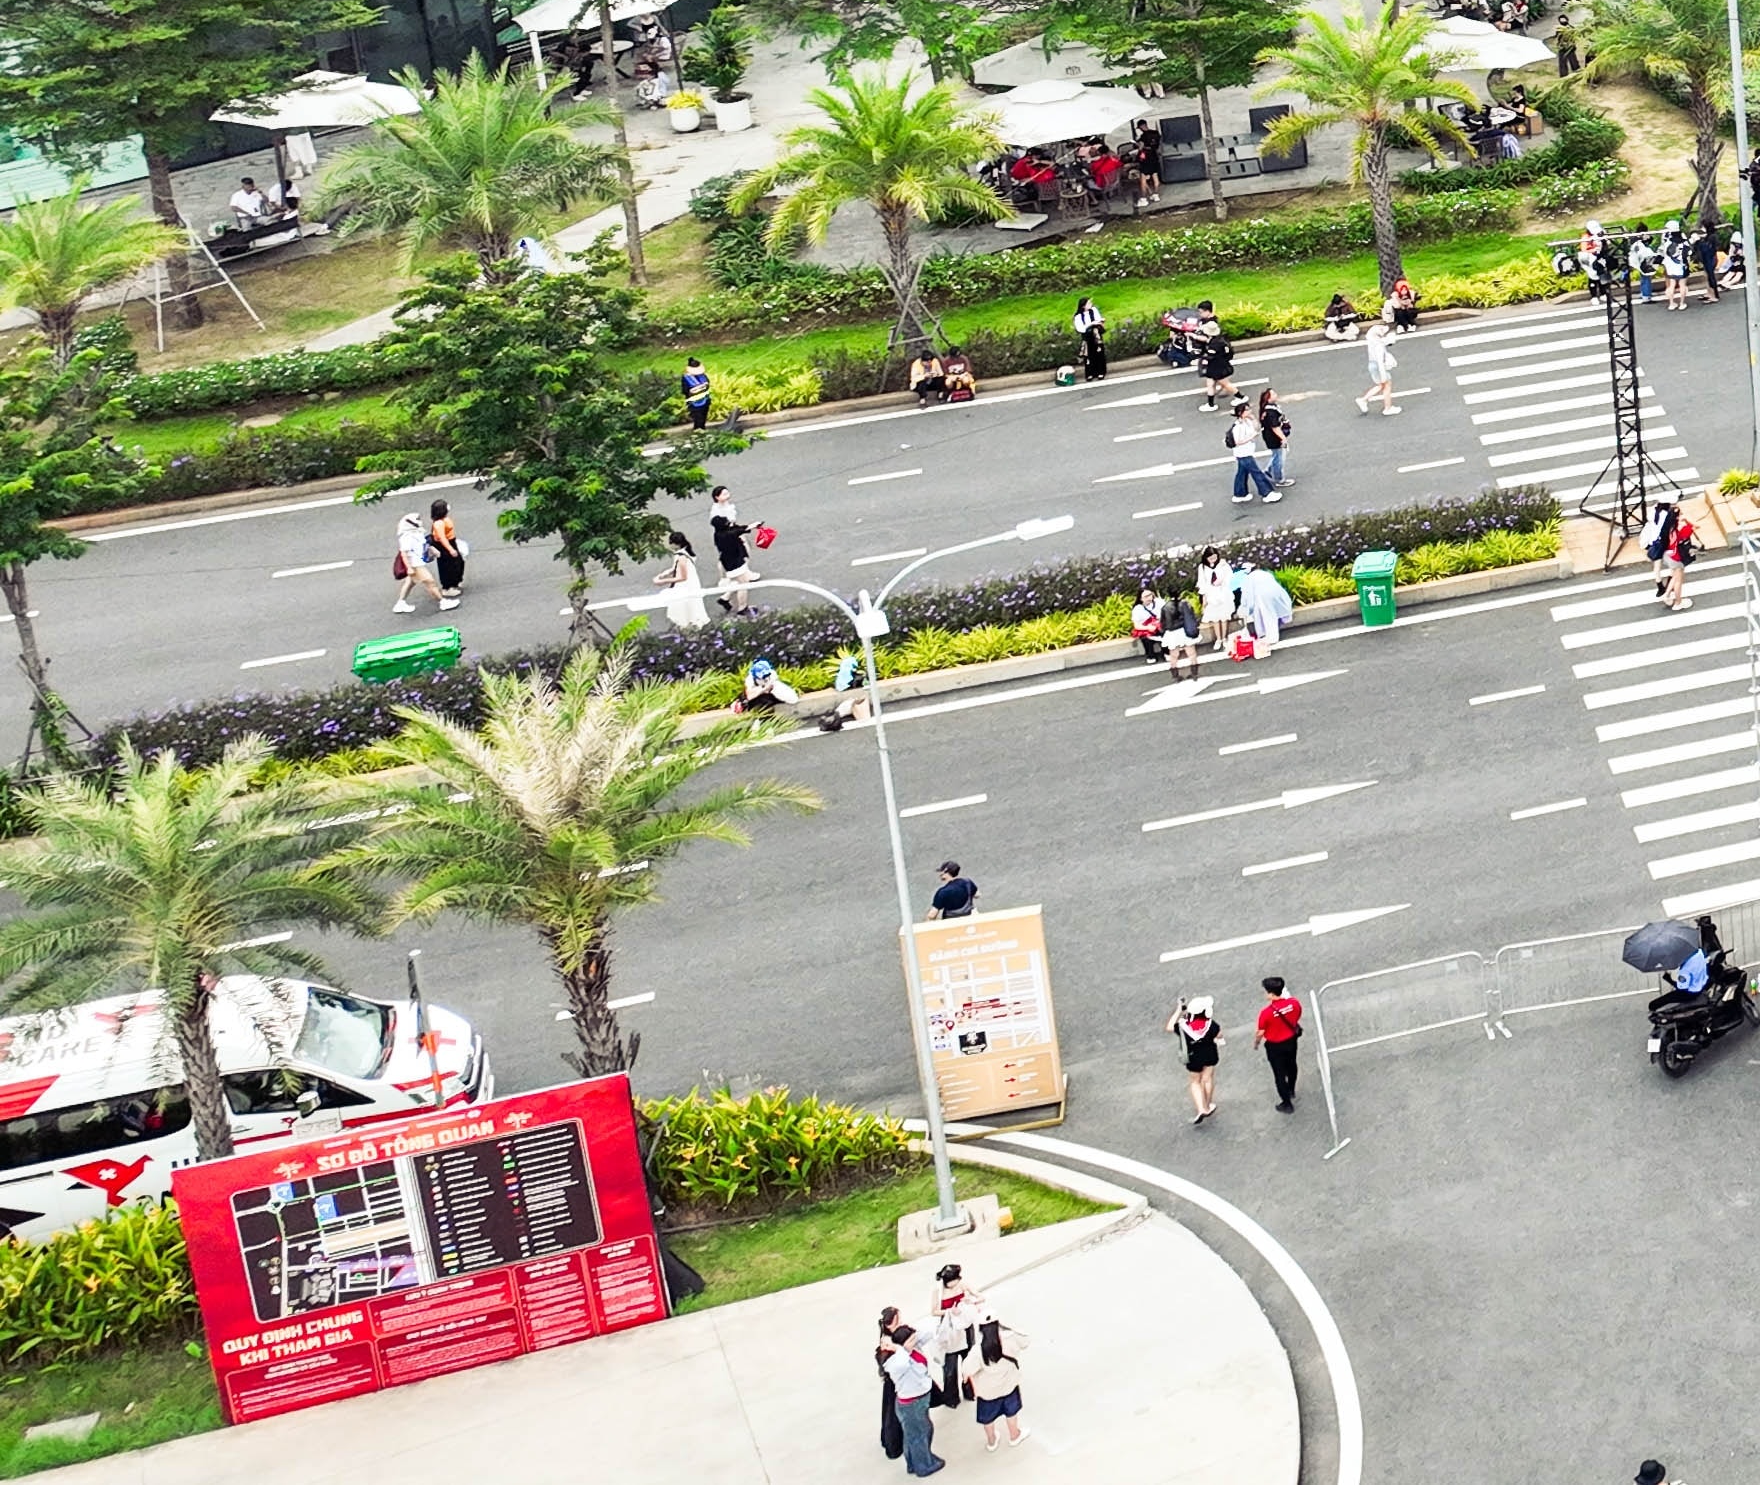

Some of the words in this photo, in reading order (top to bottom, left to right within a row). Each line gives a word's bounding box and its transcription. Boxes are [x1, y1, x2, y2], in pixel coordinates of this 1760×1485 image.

[316, 1148, 345, 1172] SƠ
[348, 1144, 378, 1164] ĐỒ
[380, 1132, 437, 1157] TỔNG
[439, 1120, 495, 1145] QUAN
[222, 1333, 260, 1355] QUY
[261, 1322, 304, 1345] ĐỊNH
[305, 1310, 364, 1334] CHUNG
[239, 1347, 270, 1366] KHI
[271, 1337, 322, 1361] THAM
[325, 1329, 353, 1348] GIA
